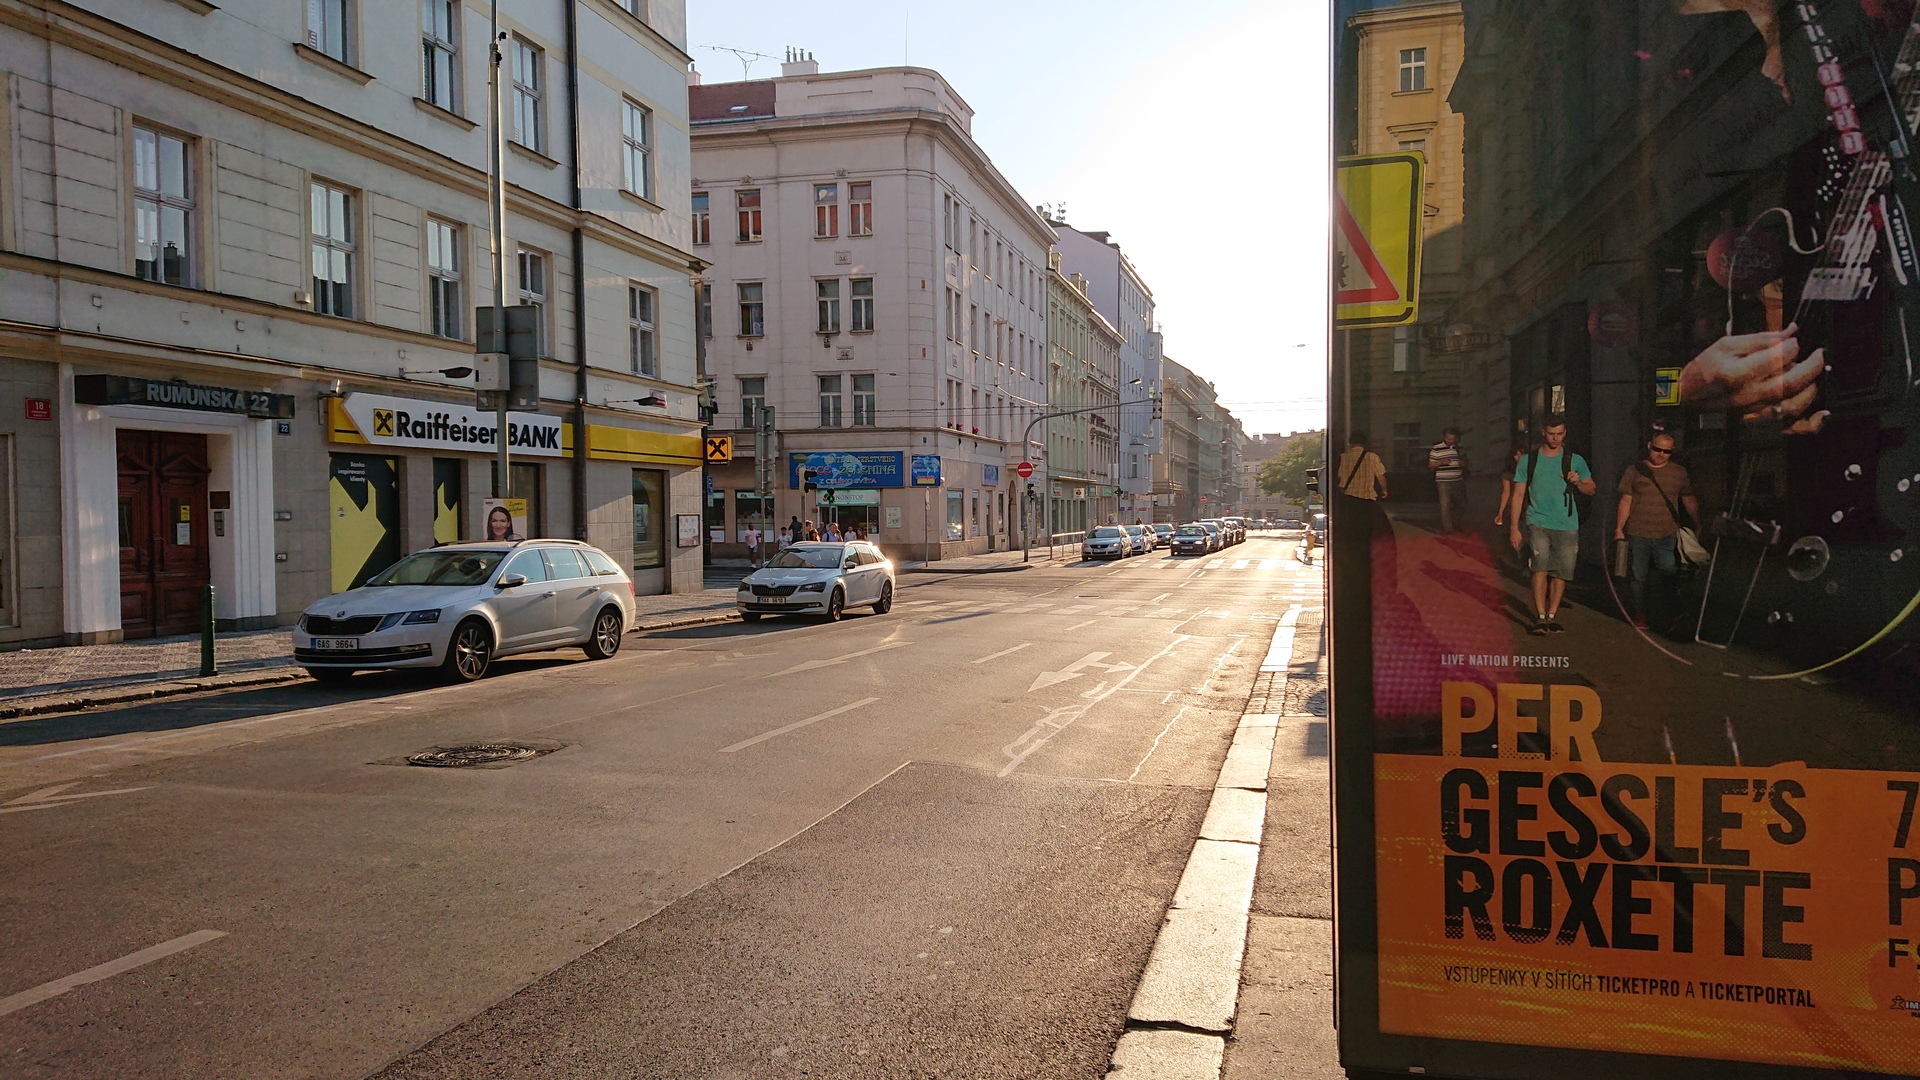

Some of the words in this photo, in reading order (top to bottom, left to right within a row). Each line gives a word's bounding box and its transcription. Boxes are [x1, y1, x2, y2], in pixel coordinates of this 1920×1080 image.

[35, 401, 44, 410] 18
[250, 394, 270, 412] 22
[280, 424, 289, 433] 22
[507, 422, 560, 450] BANK
[839, 465, 896, 475] ZELENINA
[317, 640, 330, 649] 6AS
[335, 640, 354, 649] 9664
[1441, 653, 1465, 666] LIVE
[1469, 654, 1509, 667] NATION
[1512, 655, 1570, 669] PRESENTS
[1441, 681, 1603, 763] PER
[1440, 768, 1807, 867] GESSLE'S
[1443, 855, 1813, 961] ROXETTE
[1443, 965, 1526, 987] VSTUPENKY
[1531, 971, 1543, 988] V
[1545, 968, 1593, 991] SÍTÍCH
[1596, 975, 1680, 998] TICKETPRO
[1685, 980, 1696, 999] A
[1699, 981, 1816, 1009] TICKETPORTAL
